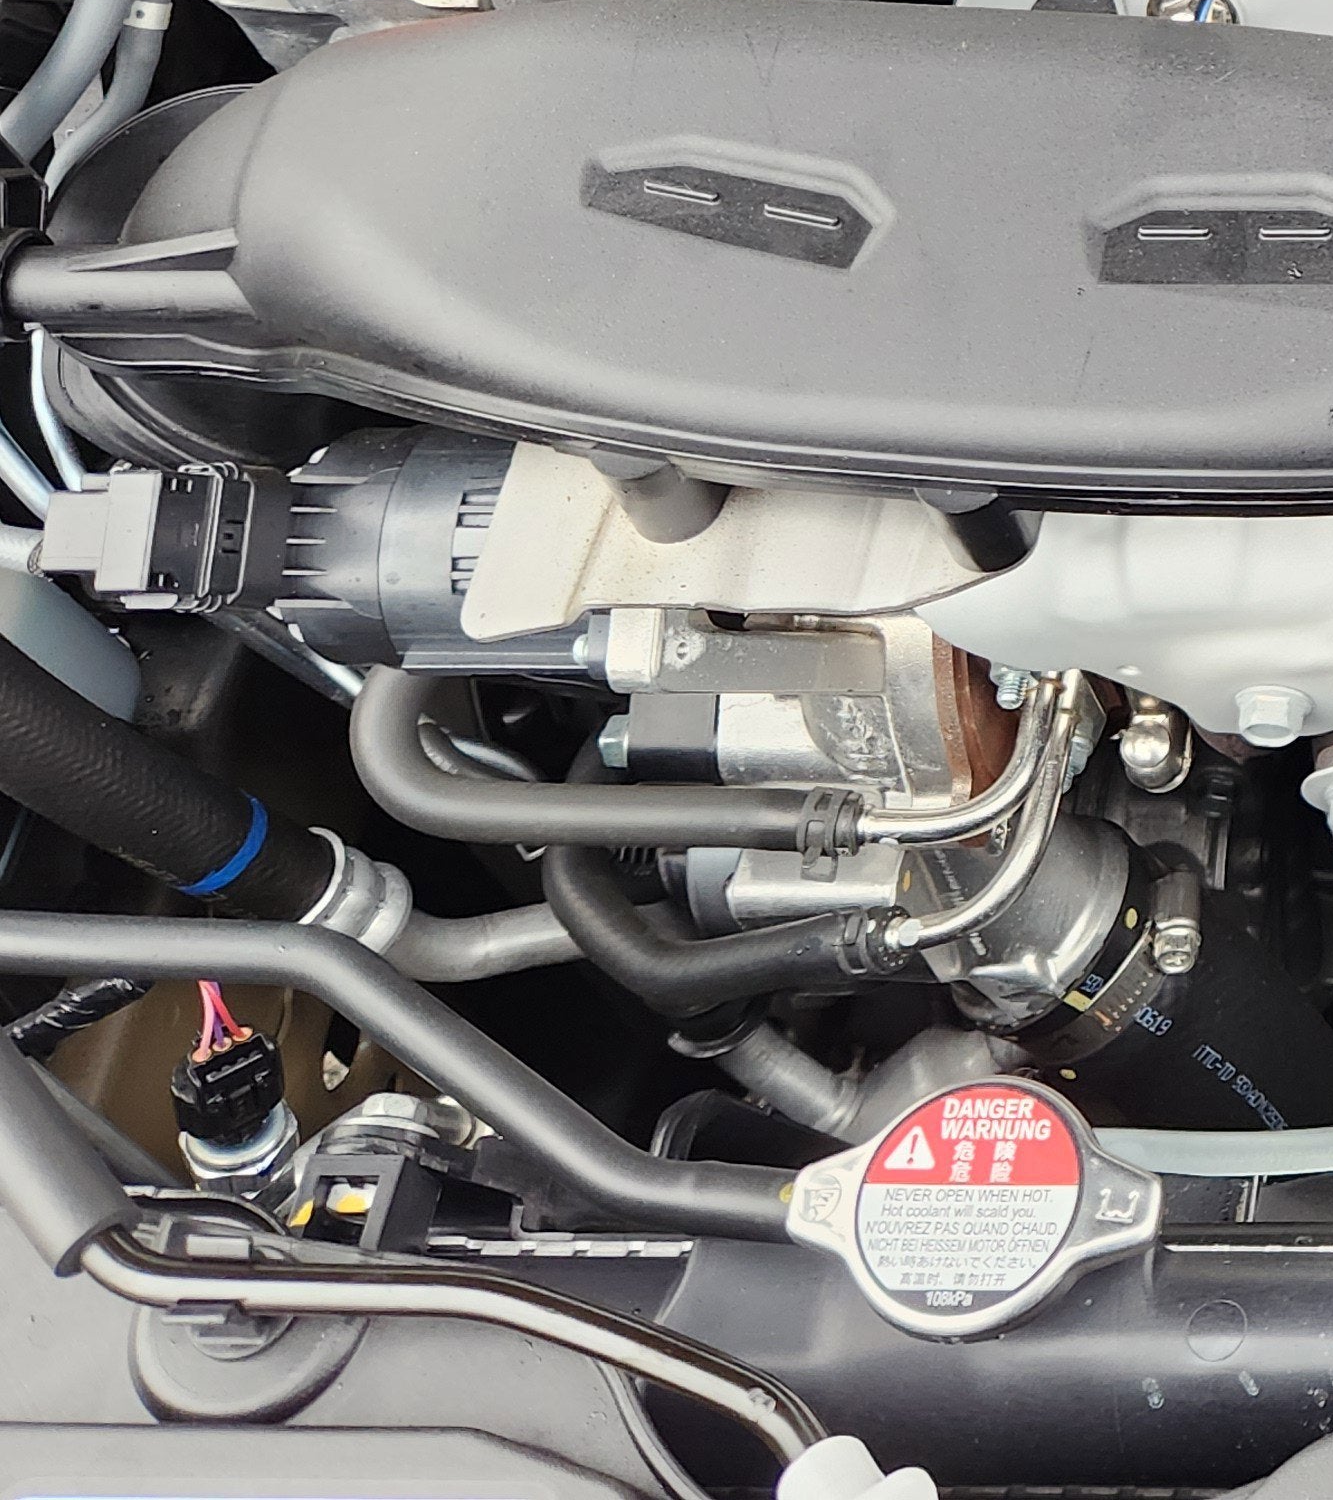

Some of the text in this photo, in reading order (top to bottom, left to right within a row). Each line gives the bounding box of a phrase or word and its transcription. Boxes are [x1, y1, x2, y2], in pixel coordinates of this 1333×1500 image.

[944, 1098, 1033, 1119] DANGER
[940, 1117, 1052, 1141] WARNUNG
[885, 1188, 1054, 1203] NEVER OPEN WHEN HOT.
[881, 1204, 1037, 1220] Hot coolant will scald you.
[864, 1220, 1060, 1236] N'OUVREZ PAS QUAND CHAUD.
[867, 1238, 899, 1252] NICHT
[900, 1239, 919, 1252] BEI
[919, 1239, 966, 1252] HEISSEM
[967, 1239, 1006, 1252] MOTOR
